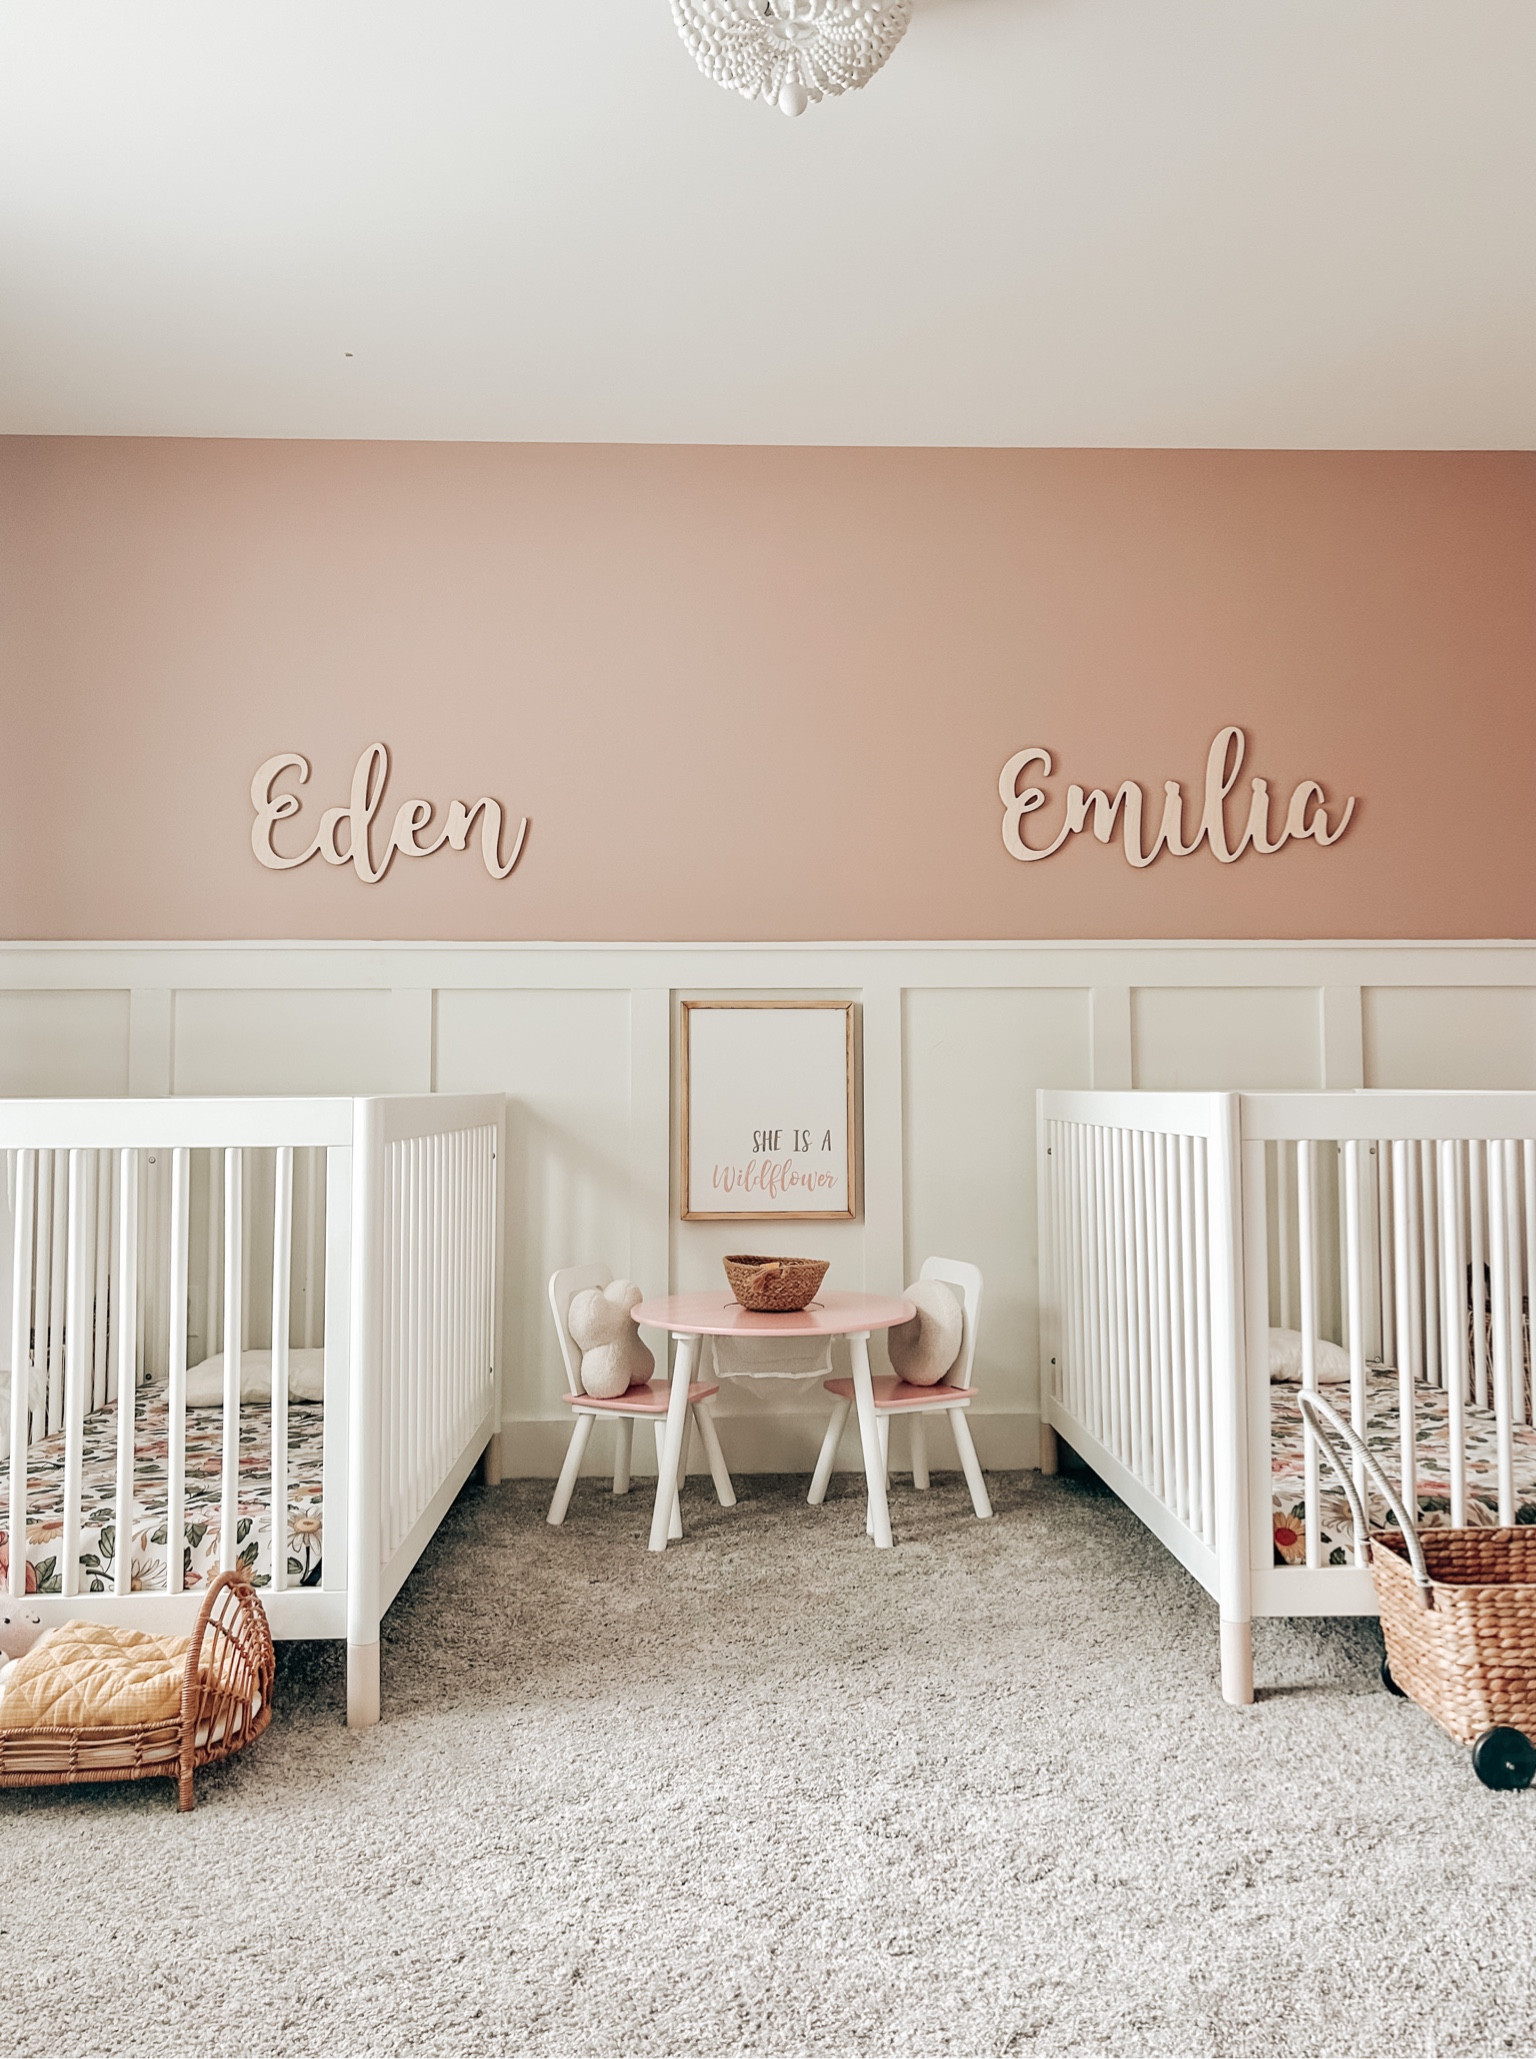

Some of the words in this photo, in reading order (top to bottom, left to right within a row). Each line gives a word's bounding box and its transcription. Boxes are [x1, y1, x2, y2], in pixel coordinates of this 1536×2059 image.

[250, 742, 527, 883] Eden
[998, 726, 1355, 868] Emilia
[712, 1158, 839, 1199] Wildflower
[752, 1129, 783, 1153] SHE
[793, 1129, 813, 1153] IS
[821, 1129, 832, 1151] A
